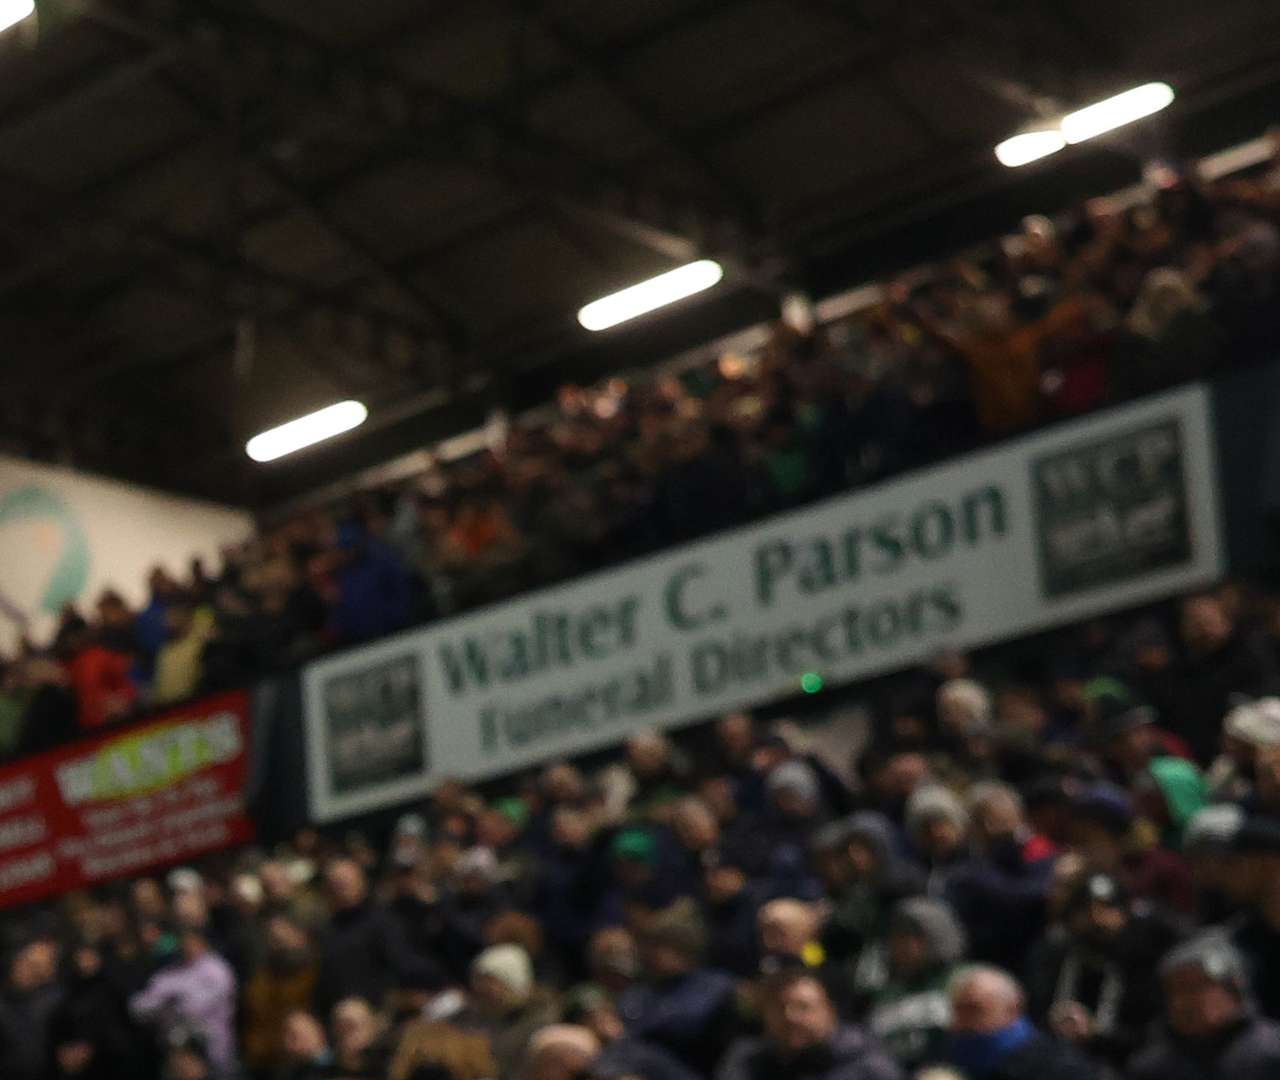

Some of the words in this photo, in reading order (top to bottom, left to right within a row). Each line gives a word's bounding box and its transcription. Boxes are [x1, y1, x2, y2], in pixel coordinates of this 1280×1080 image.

[433, 592, 639, 698] Walter
[662, 568, 727, 634] C.
[751, 482, 1008, 604] Parson
[475, 654, 684, 754] Funeral
[690, 579, 963, 708] Directors
